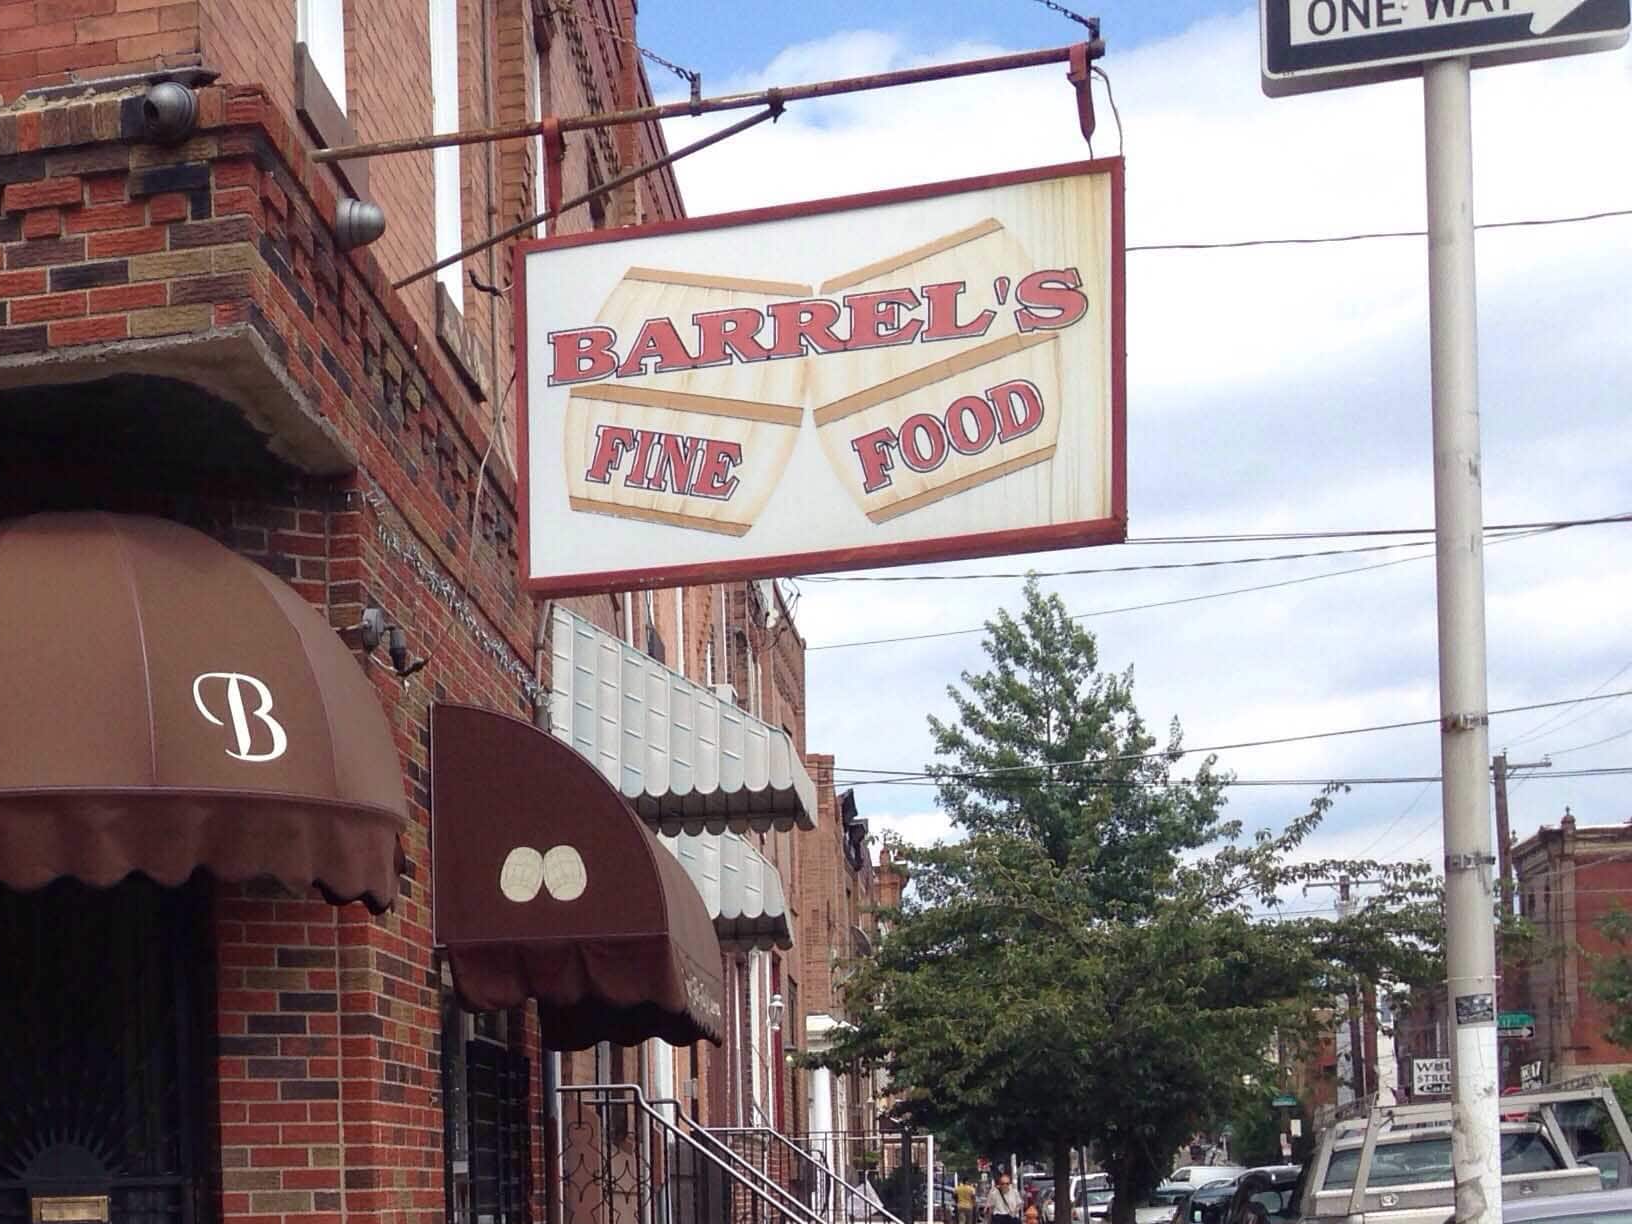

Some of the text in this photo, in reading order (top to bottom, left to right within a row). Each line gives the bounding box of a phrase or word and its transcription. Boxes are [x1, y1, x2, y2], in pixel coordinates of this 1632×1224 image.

[547, 267, 1088, 387] BARREL'S
[585, 378, 1045, 500] FINE FOOD
[193, 672, 287, 761] B
[1416, 1074, 1451, 1084] STRE
